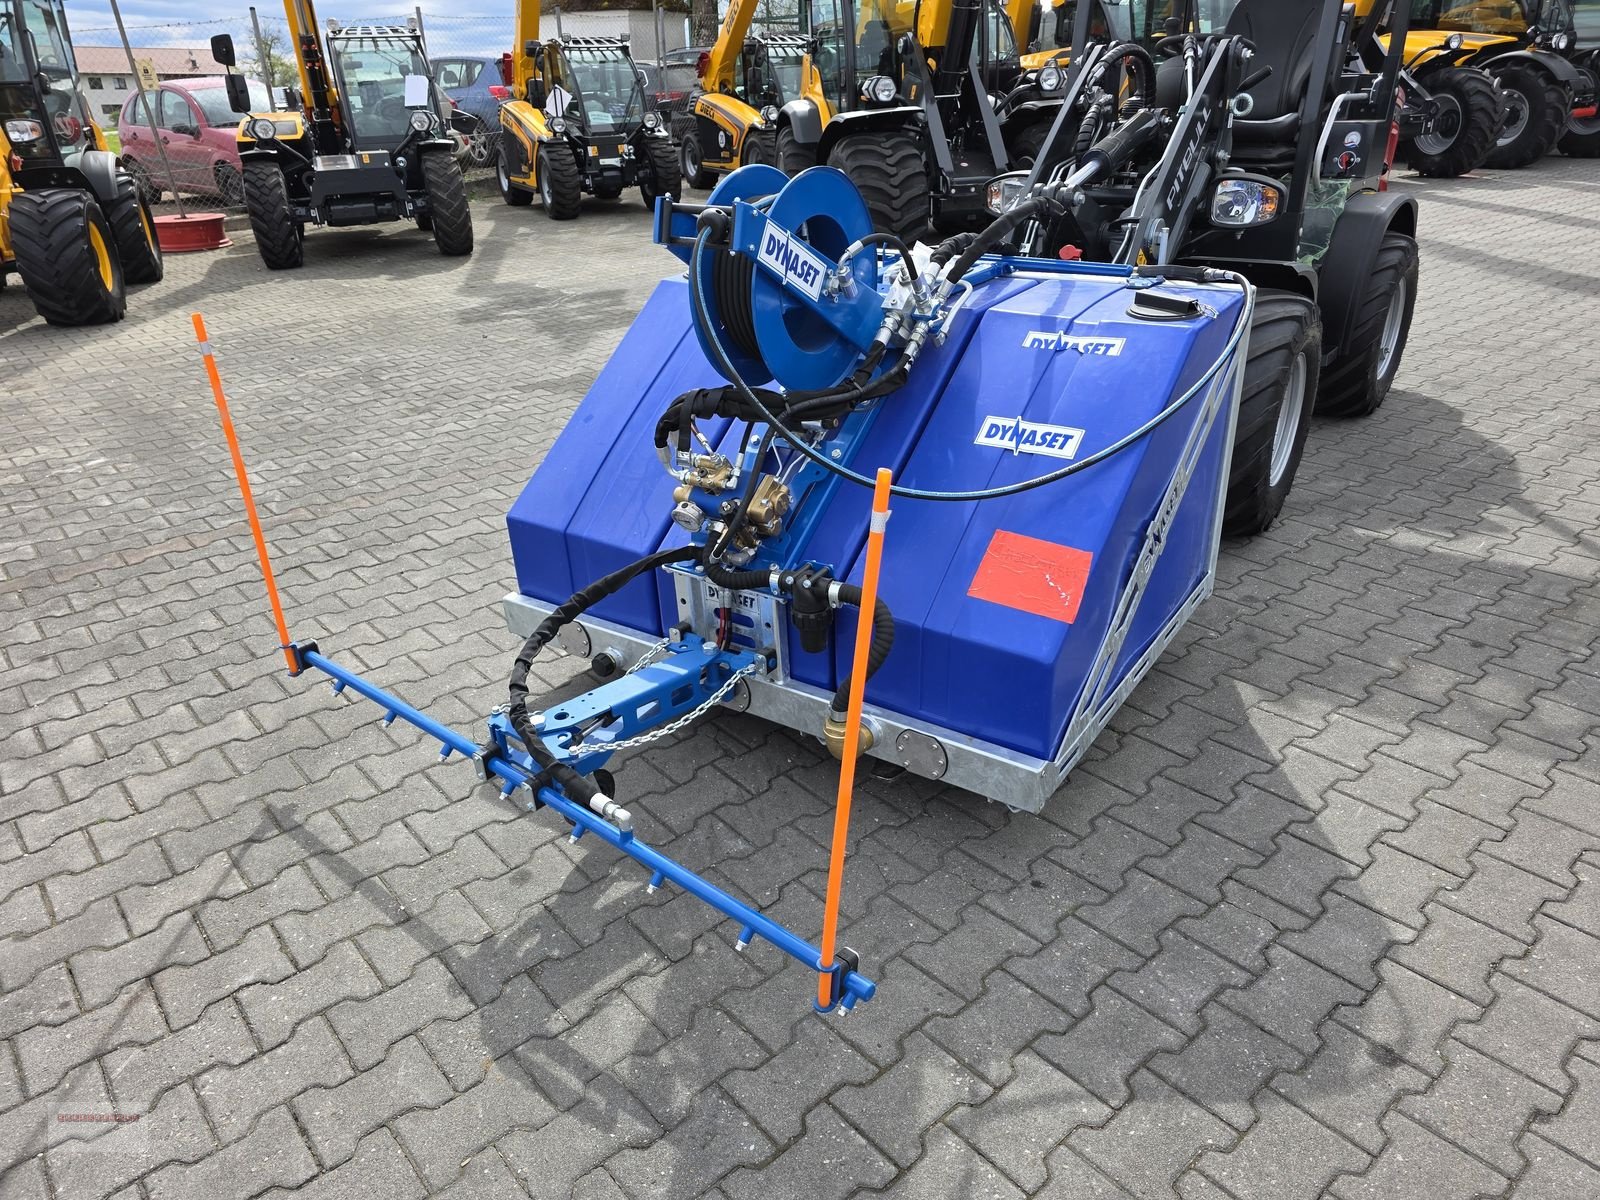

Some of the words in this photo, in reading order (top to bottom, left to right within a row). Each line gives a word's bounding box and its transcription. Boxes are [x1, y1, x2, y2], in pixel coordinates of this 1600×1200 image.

[1166, 106, 1212, 211] PITBULL
[765, 233, 820, 288] DYNASET
[985, 420, 1074, 450] DYNASET
[707, 585, 755, 609] DSET
